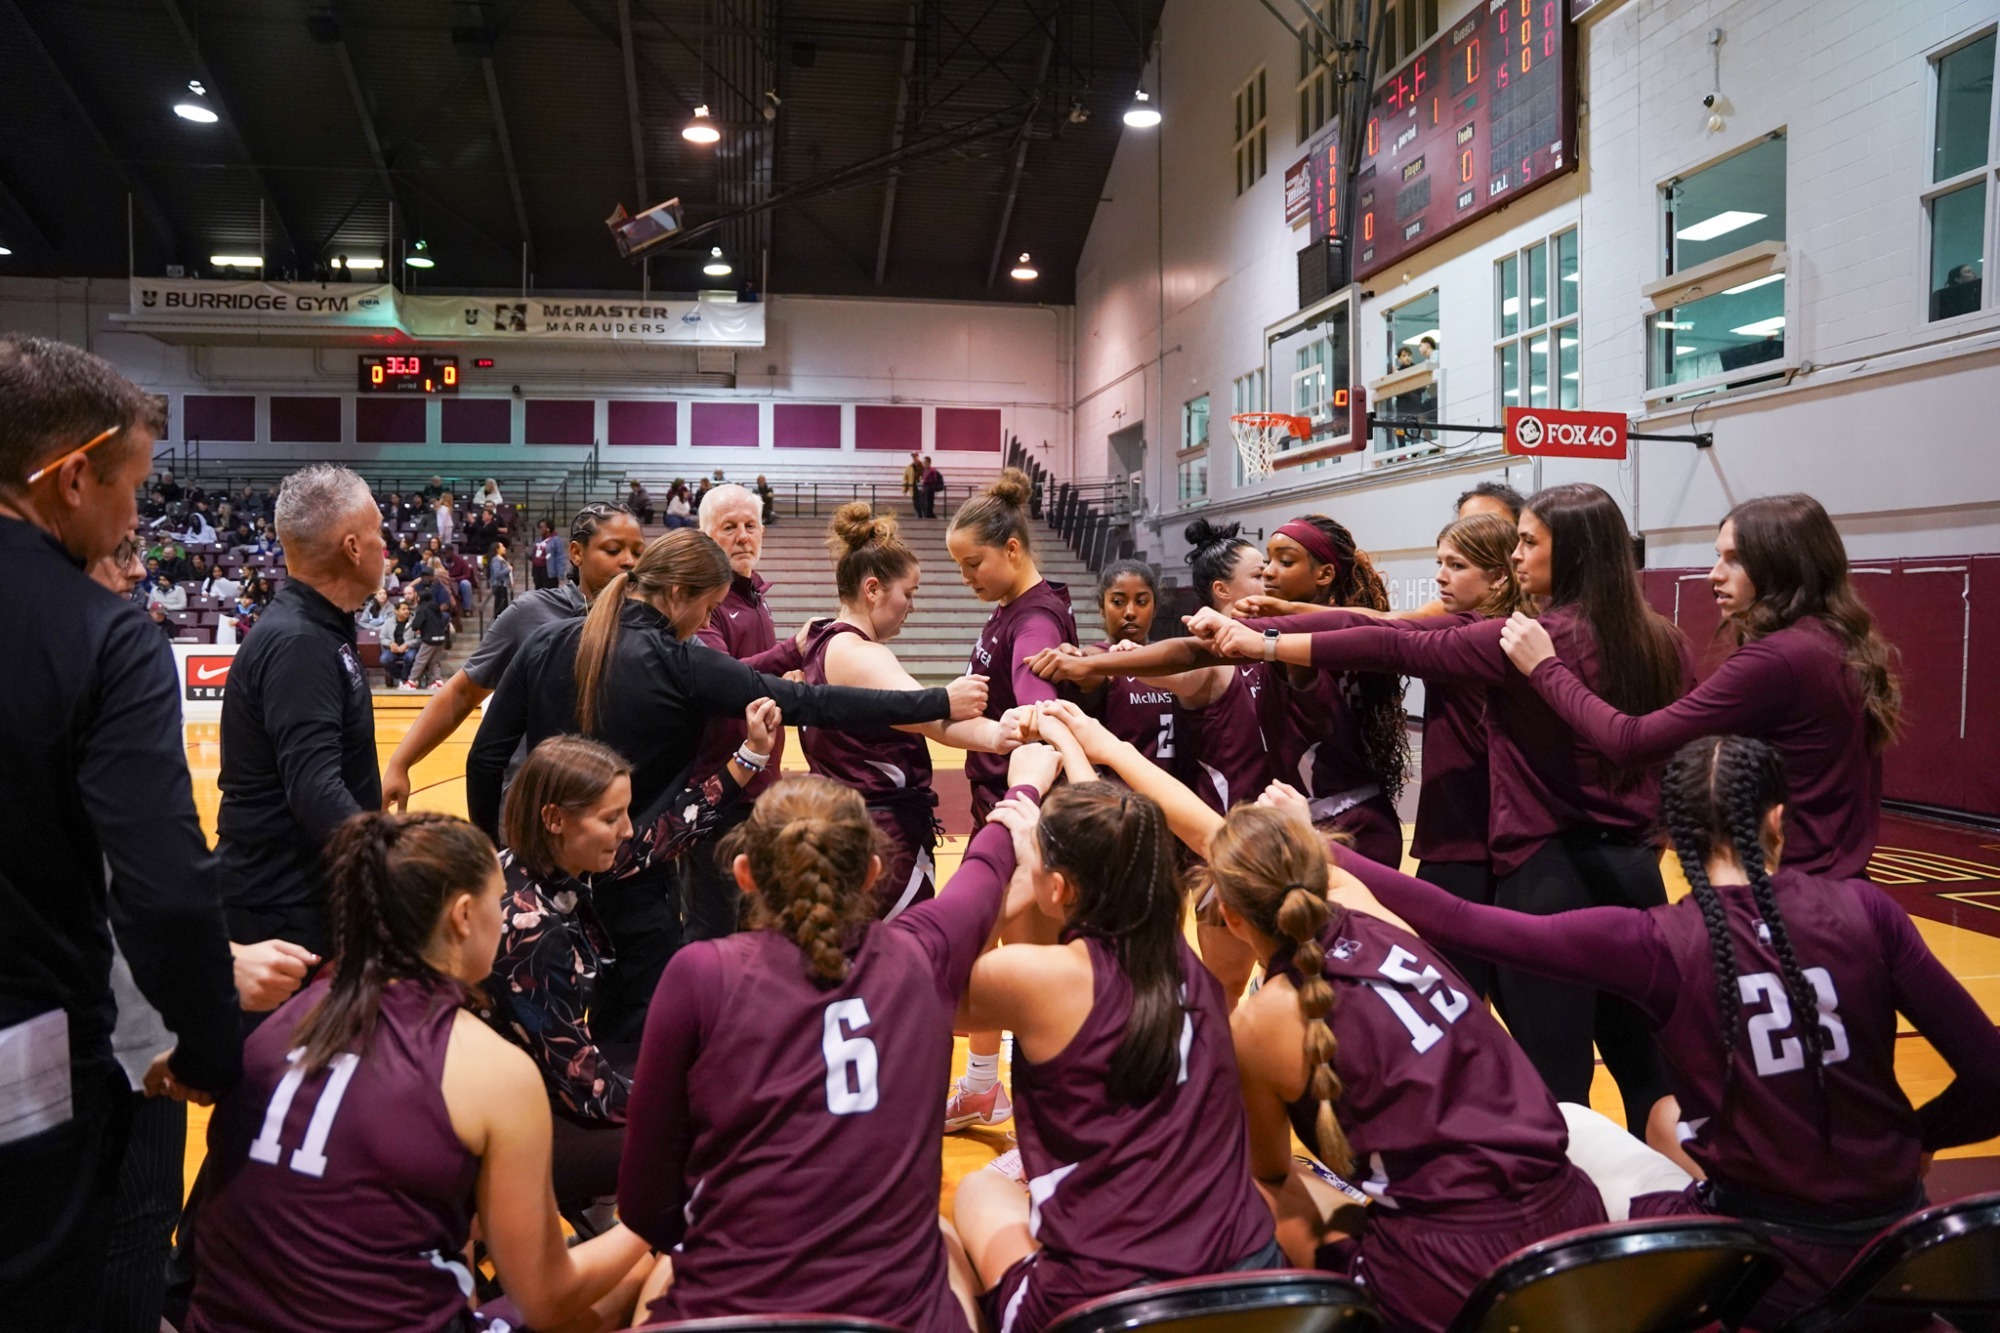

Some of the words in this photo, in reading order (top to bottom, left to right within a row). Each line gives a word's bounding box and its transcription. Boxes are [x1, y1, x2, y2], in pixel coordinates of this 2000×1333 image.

[1453, 19, 1475, 45] Guests
[1521, 19, 1531, 46] 0
[1466, 38, 1480, 84] 0
[1521, 47, 1531, 73] 0
[1497, 62, 1509, 88] 15
[1368, 116, 1379, 157] 0
[1398, 123, 1417, 149] period
[1457, 126, 1473, 146] fouls
[1404, 159, 1422, 181] player
[1462, 149, 1473, 183] 0
[1521, 157, 1532, 183] 5
[1459, 191, 1472, 208] won
[1364, 211, 1374, 241] 0
[165, 291, 287, 310] BURRIDGE
[296, 296, 349, 312] GYM
[542, 304, 669, 319] McMASTER
[546, 322, 666, 334] MARAUDERS
[372, 365, 383, 383] 0
[443, 366, 456, 384] 0
[1335, 389, 1348, 406] 0
[1129, 692, 1173, 705] McMAS
[1156, 713, 1175, 758] 2
[1361, 944, 1469, 1054] 15
[822, 997, 879, 1115] 6
[249, 1045, 361, 1177] 11
